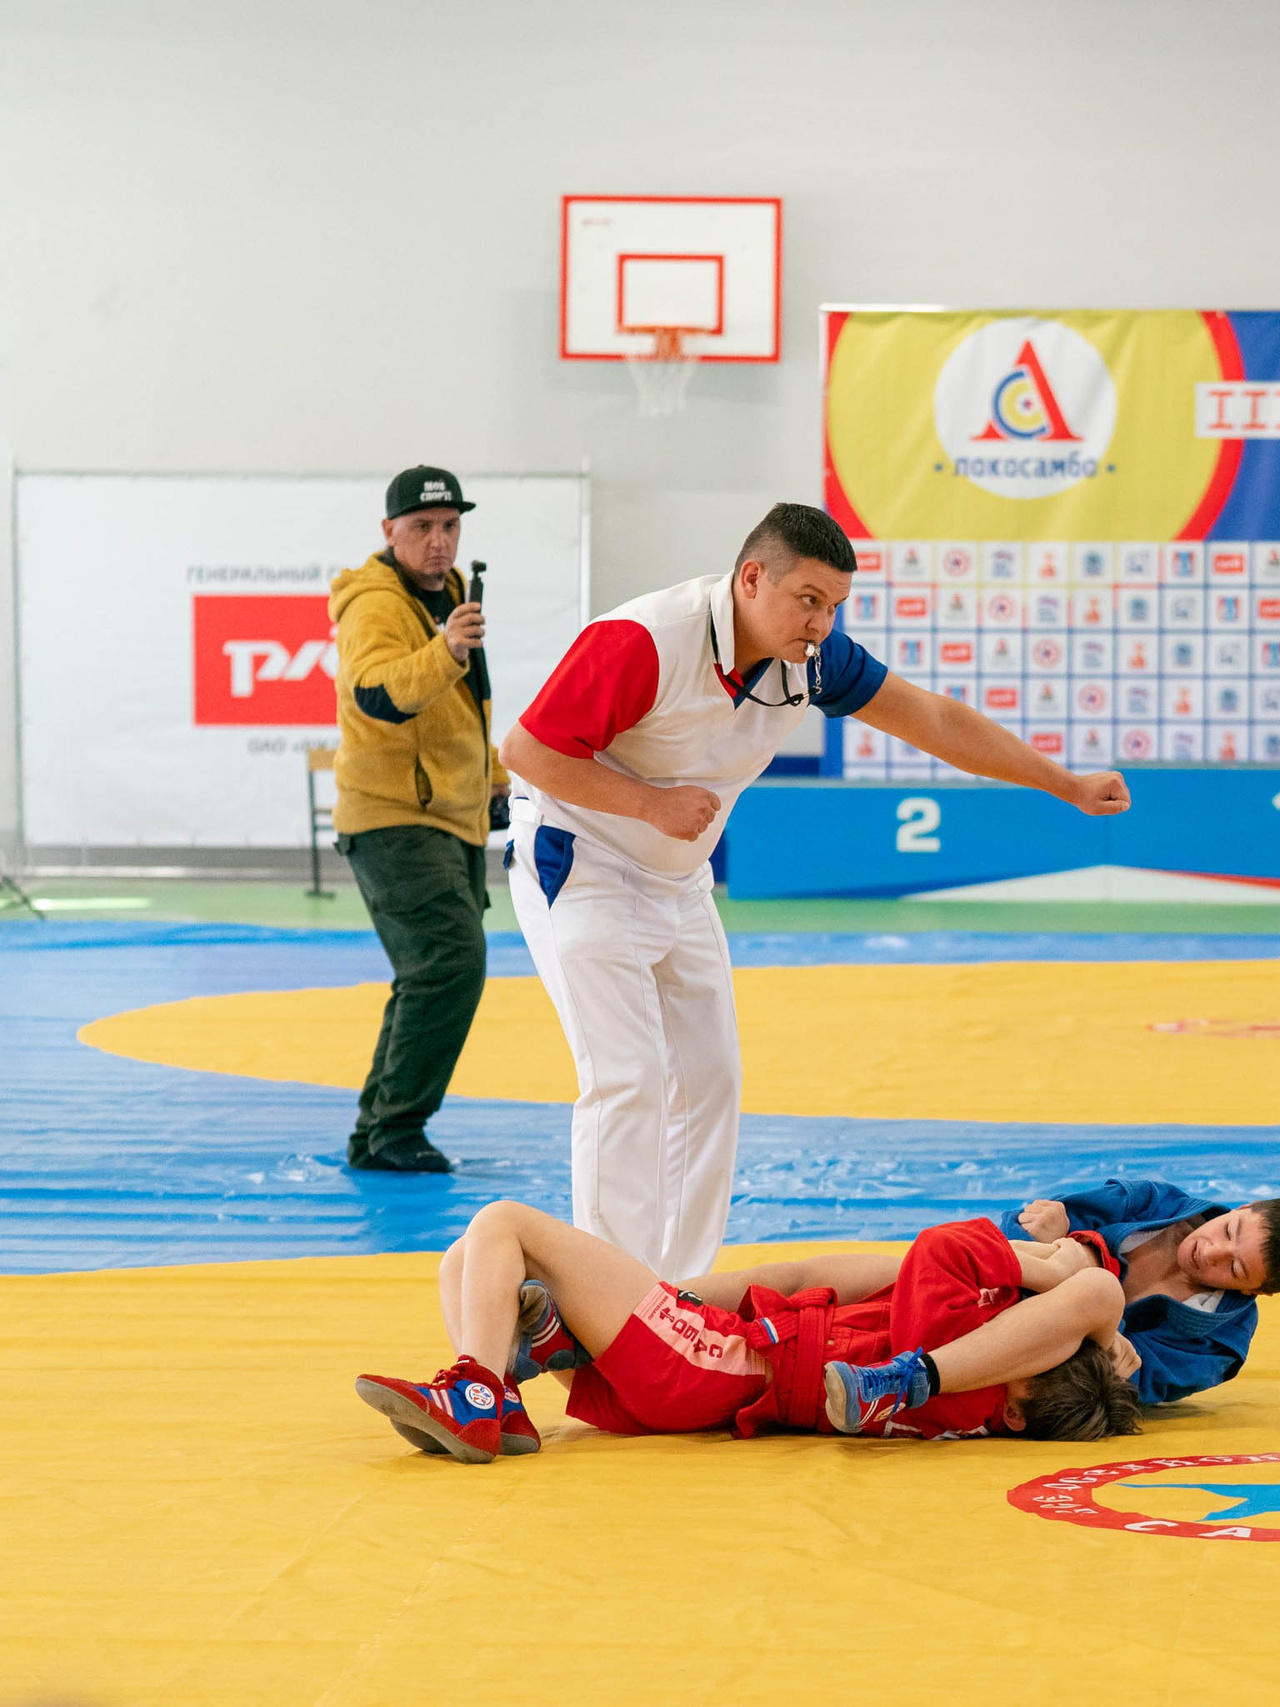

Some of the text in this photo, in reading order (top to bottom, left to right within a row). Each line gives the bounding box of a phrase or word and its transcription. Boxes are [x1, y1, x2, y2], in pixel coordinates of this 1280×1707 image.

[187, 564, 322, 582] ГЕНЕРАЛЬНЫЙ
[222, 626, 339, 698] РЖ
[248, 738, 285, 754] ОАО
[896, 797, 942, 853] 2
